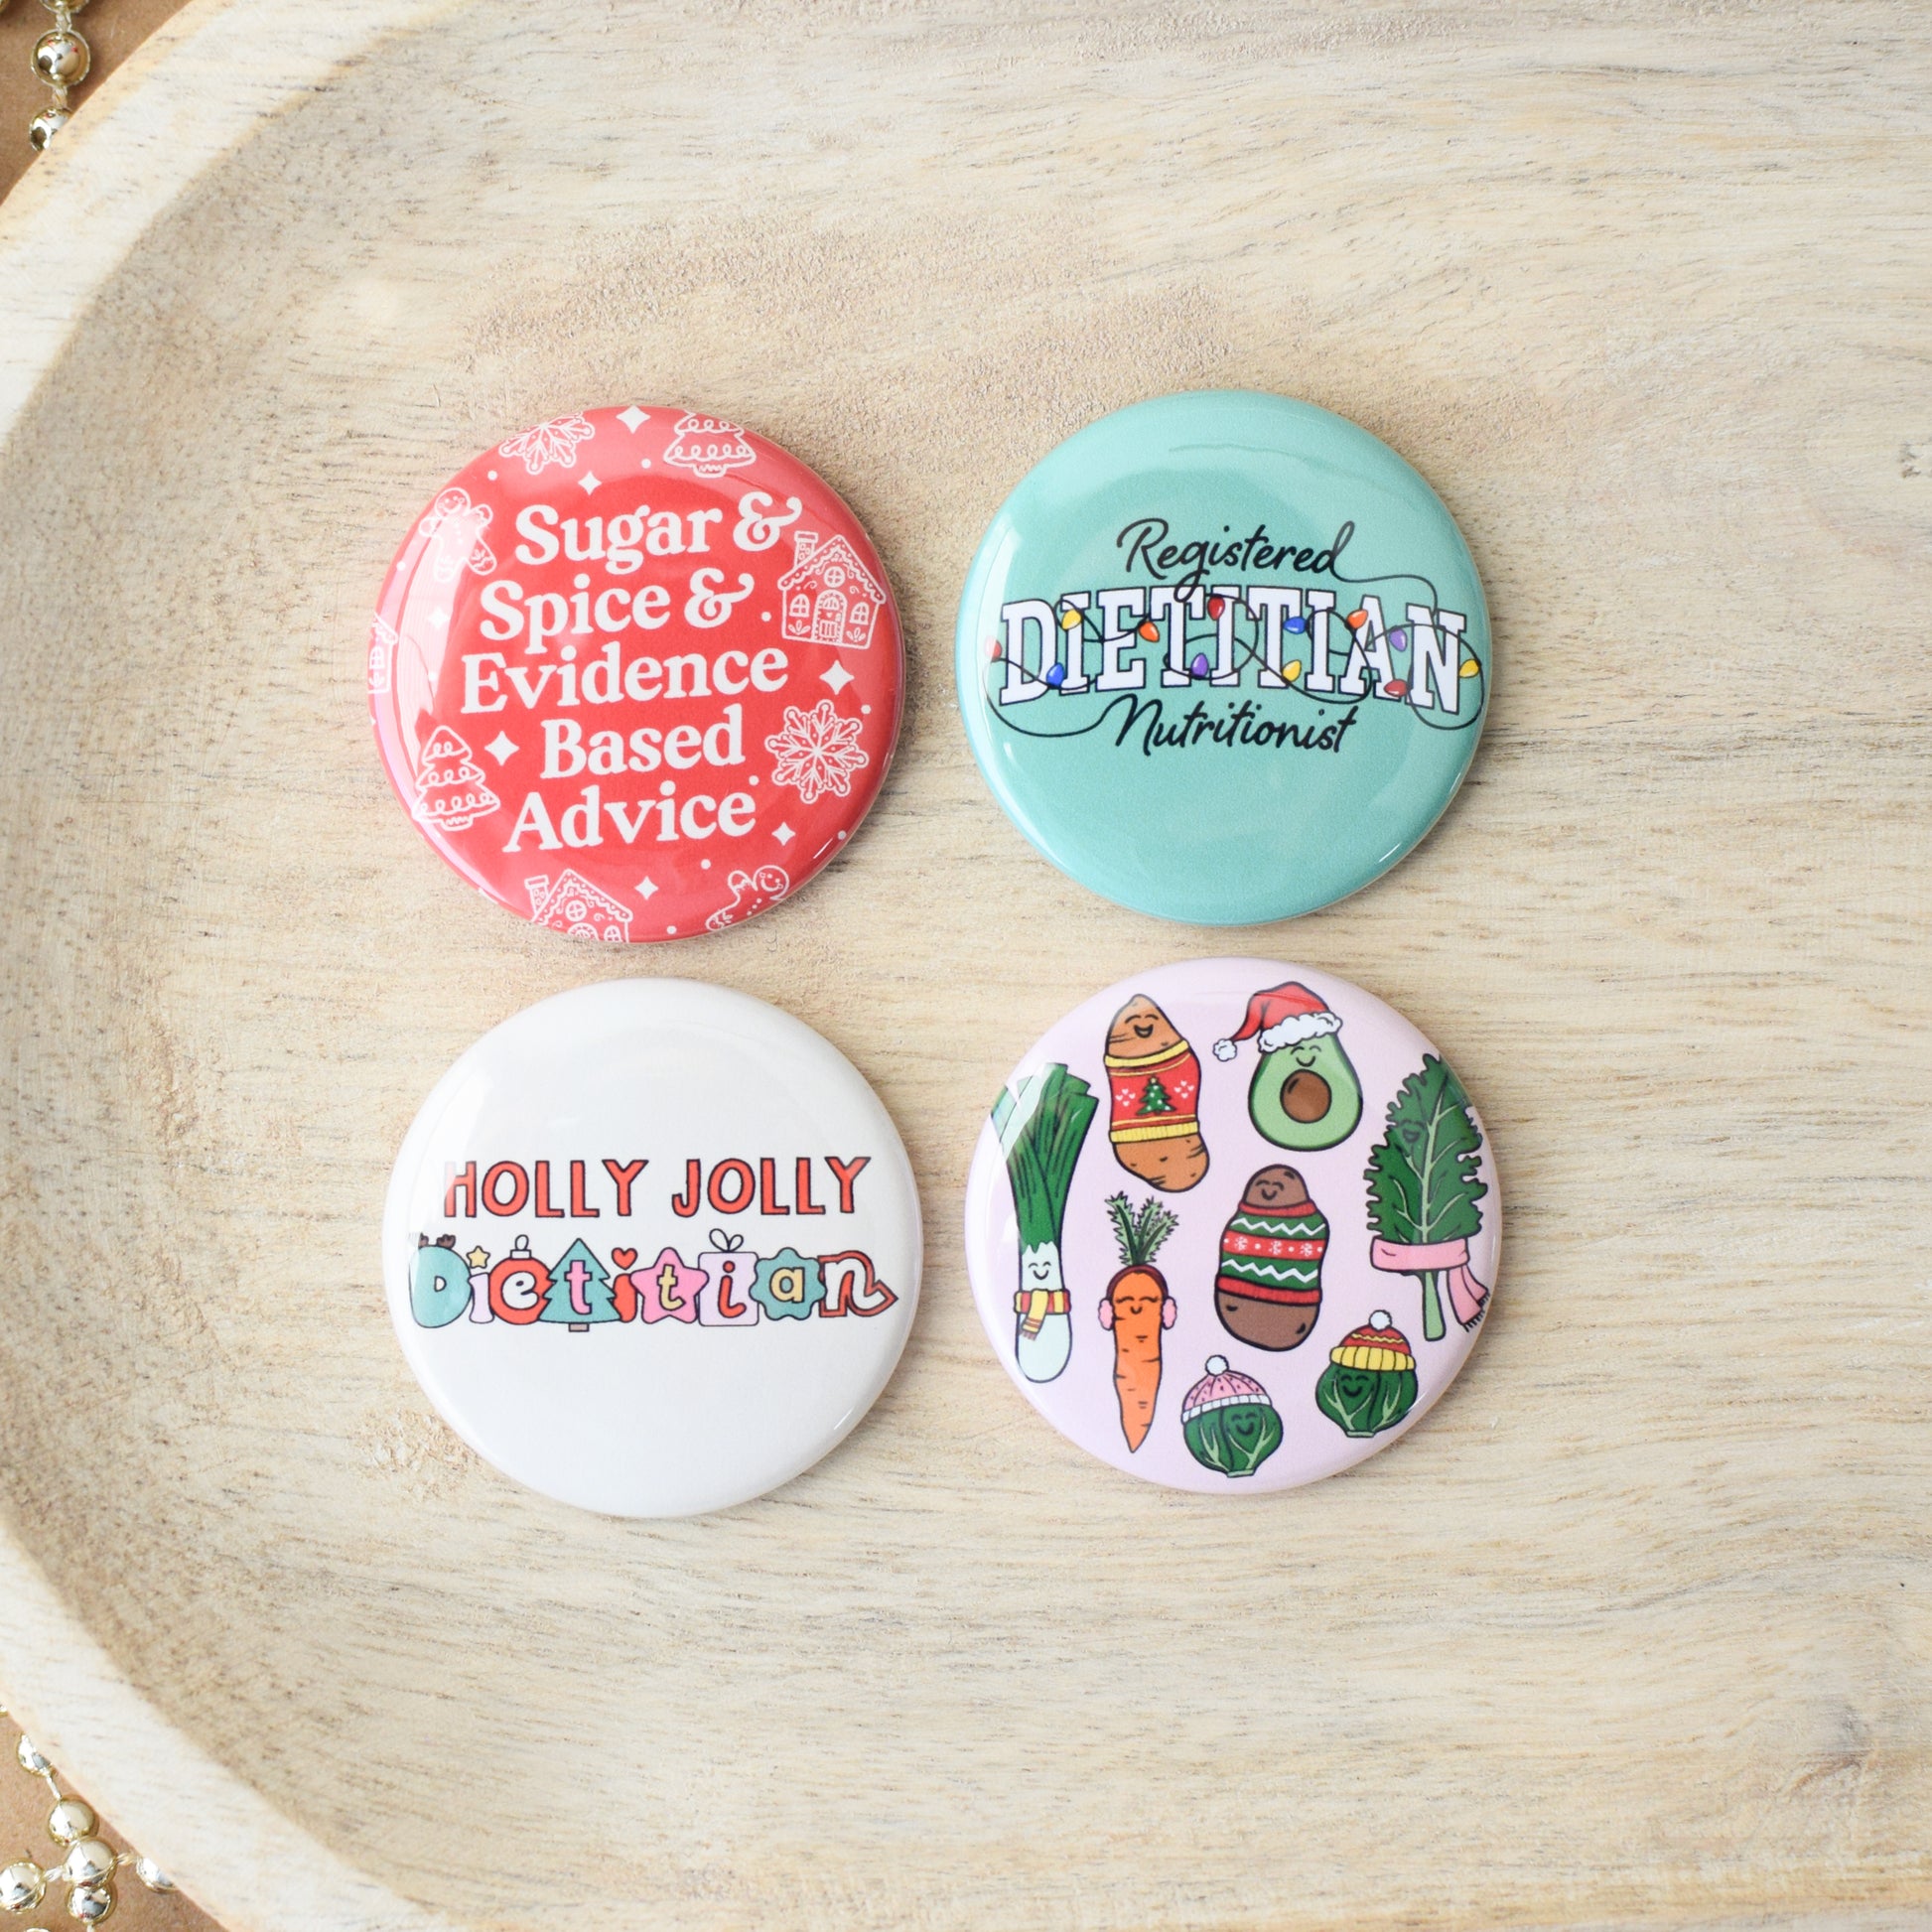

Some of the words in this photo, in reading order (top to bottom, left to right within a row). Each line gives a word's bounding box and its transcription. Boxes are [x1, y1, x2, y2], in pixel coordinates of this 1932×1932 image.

[514, 504, 723, 575] Sugar
[733, 491, 802, 552] &
[1116, 517, 1355, 602] Registered
[480, 573, 670, 655] Spice
[684, 567, 755, 628] &
[999, 584, 1466, 715] DIETITIAN
[461, 640, 788, 715] Evidence
[540, 703, 746, 779] Based
[1108, 693, 1358, 757] Nutritionist
[502, 779, 757, 853] Advice
[443, 1159, 649, 1218] HOLLY
[671, 1156, 872, 1217] JOLLY
[408, 1229, 898, 1332] Dietitian
